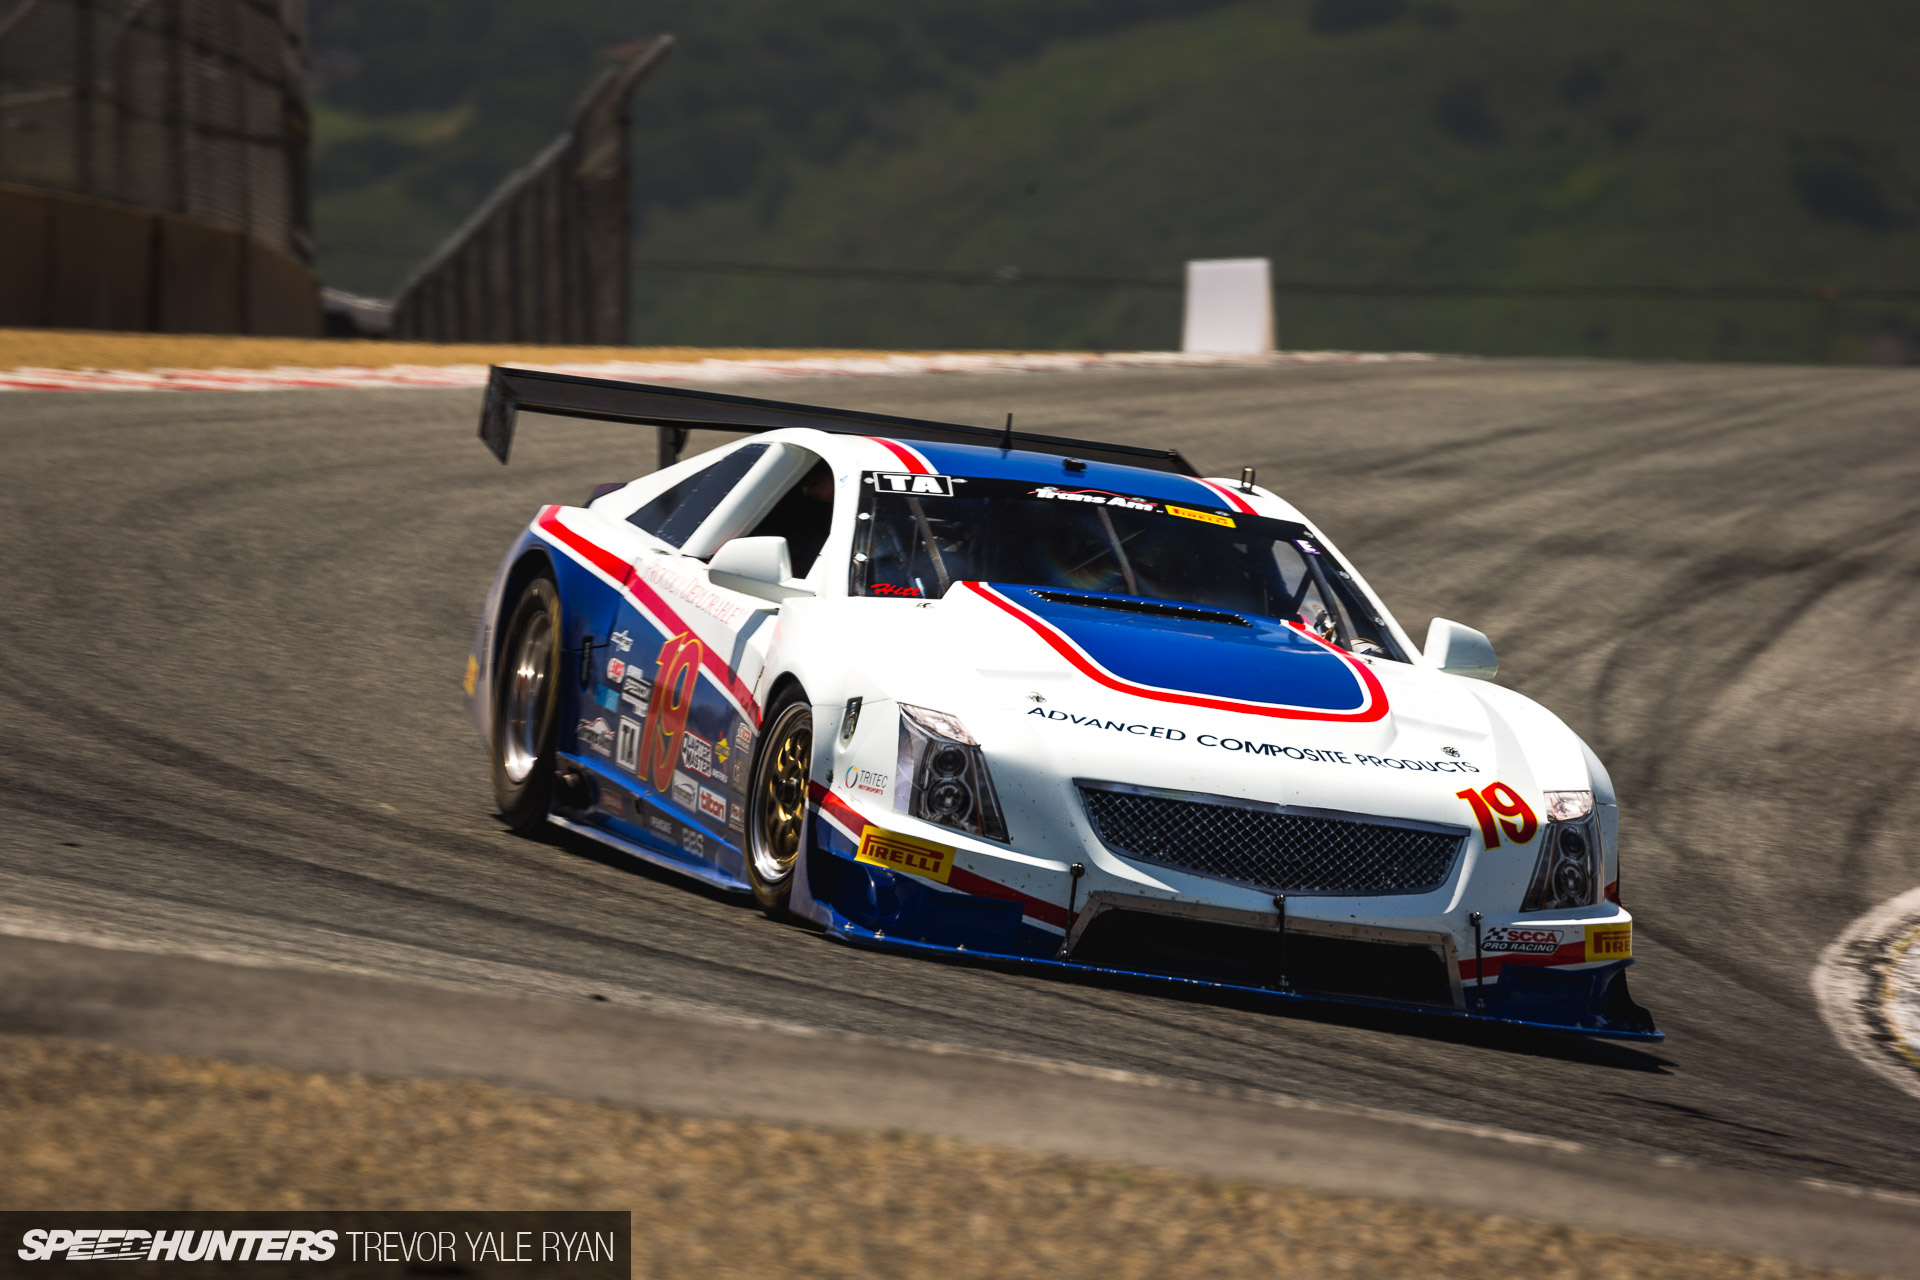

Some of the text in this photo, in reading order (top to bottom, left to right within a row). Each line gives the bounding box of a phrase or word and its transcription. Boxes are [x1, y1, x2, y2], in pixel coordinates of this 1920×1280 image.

[883, 475, 943, 493] TA
[1035, 488, 1153, 511] Trans Am
[1172, 508, 1228, 525] PIRELLI
[637, 632, 703, 793] 19
[1027, 707, 1480, 773] ADVANCED COMPOSITE PRODUCTS
[860, 769, 888, 788] TRITEC
[858, 784, 884, 796] MOTORSPORTS
[1455, 781, 1539, 851] 19
[861, 833, 944, 873] PIRELLI
[1507, 930, 1557, 943] SCCA
[1483, 942, 1556, 952] PRO RACING
